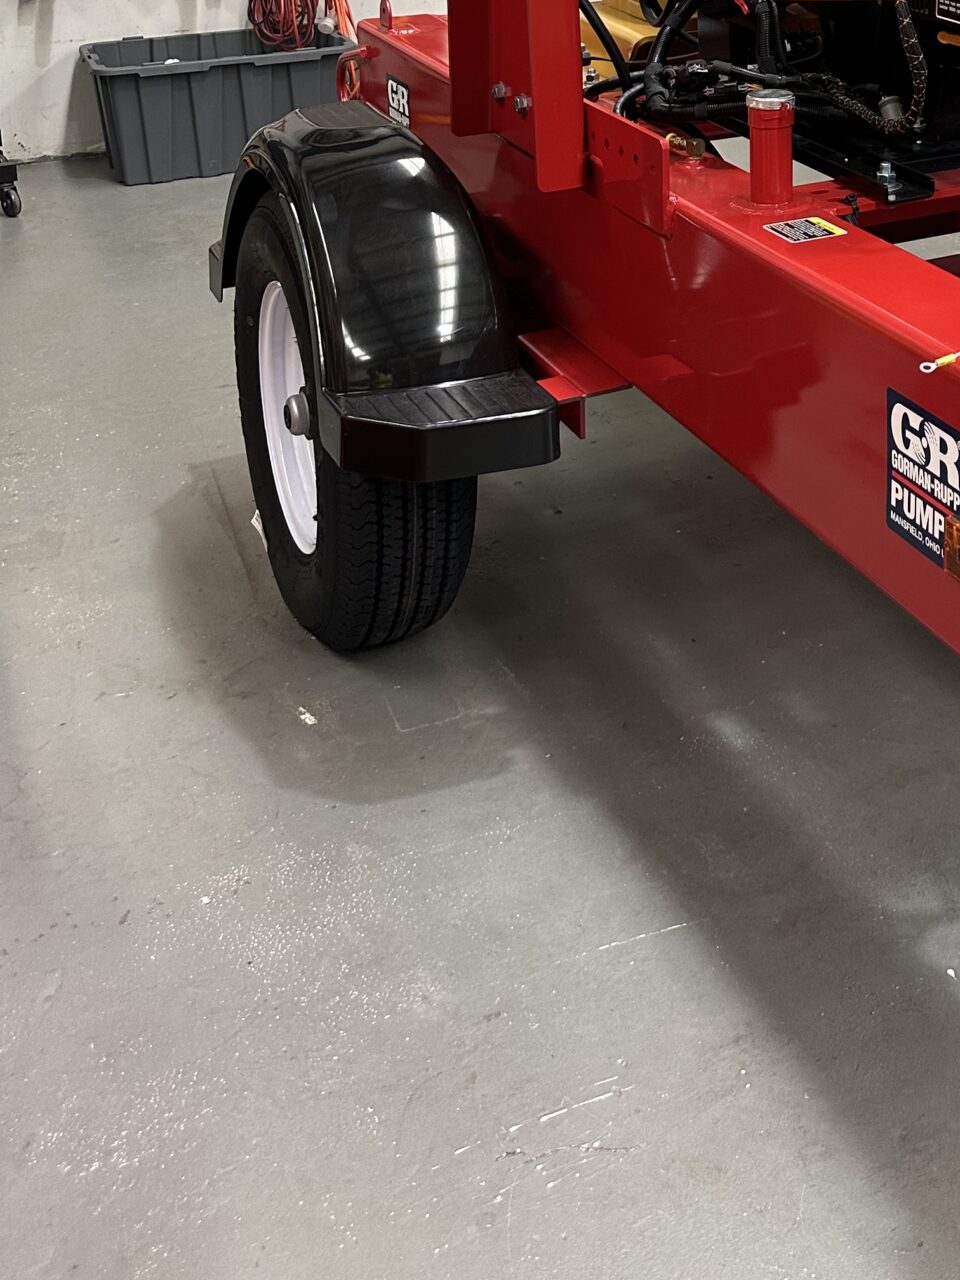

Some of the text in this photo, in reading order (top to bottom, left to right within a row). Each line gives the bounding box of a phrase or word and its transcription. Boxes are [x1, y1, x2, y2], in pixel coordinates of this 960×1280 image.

[890, 479, 945, 539] PUMP
[891, 449, 960, 511] GORMAN-RUPP
[890, 510, 941, 555] MANSFIELD, OHIO
